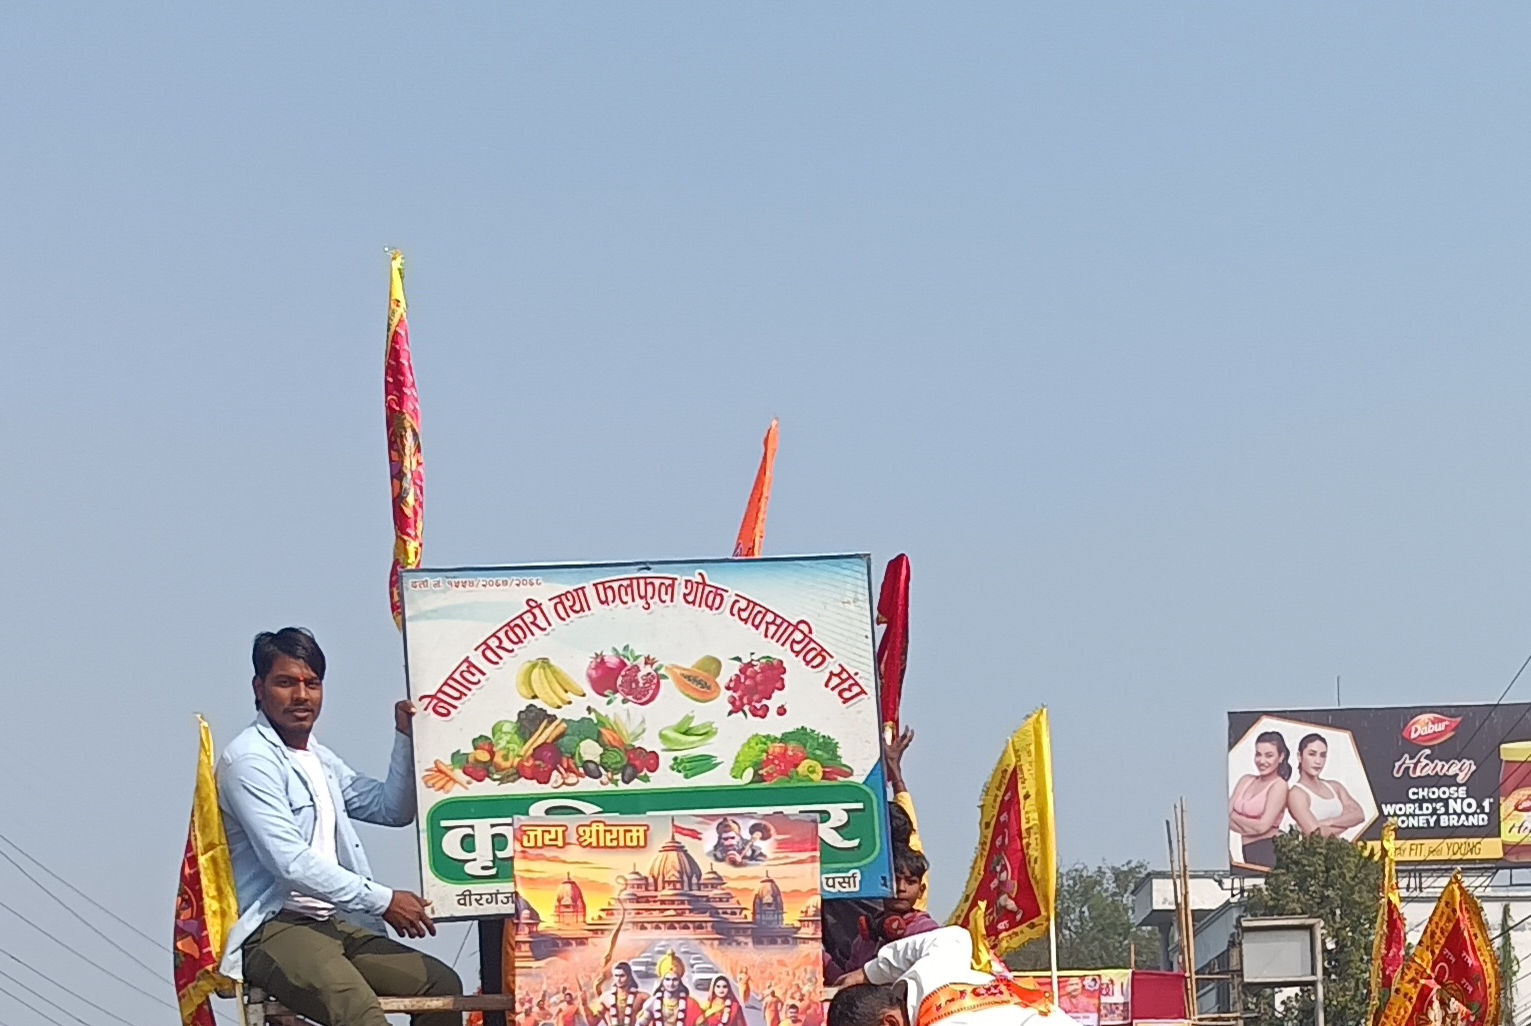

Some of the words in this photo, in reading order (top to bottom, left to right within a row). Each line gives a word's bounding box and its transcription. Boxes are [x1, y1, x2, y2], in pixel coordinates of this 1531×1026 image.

[418, 655, 487, 718] नेपाल
[474, 598, 551, 666] तरकारी
[548, 586, 592, 622] तथा
[682, 572, 729, 612] थोक
[824, 663, 869, 705] संघ
[1410, 720, 1451, 739] Dabur
[1393, 749, 1477, 784] Honey
[1408, 786, 1467, 800] CHOOSE
[1381, 801, 1446, 816] WORLD'S
[1440, 814, 1488, 827] BRAND
[521, 826, 567, 848] जय
[574, 823, 649, 849] श्रीराम
[1446, 841, 1482, 856] YOUNG
[823, 873, 859, 890] पर्सा
